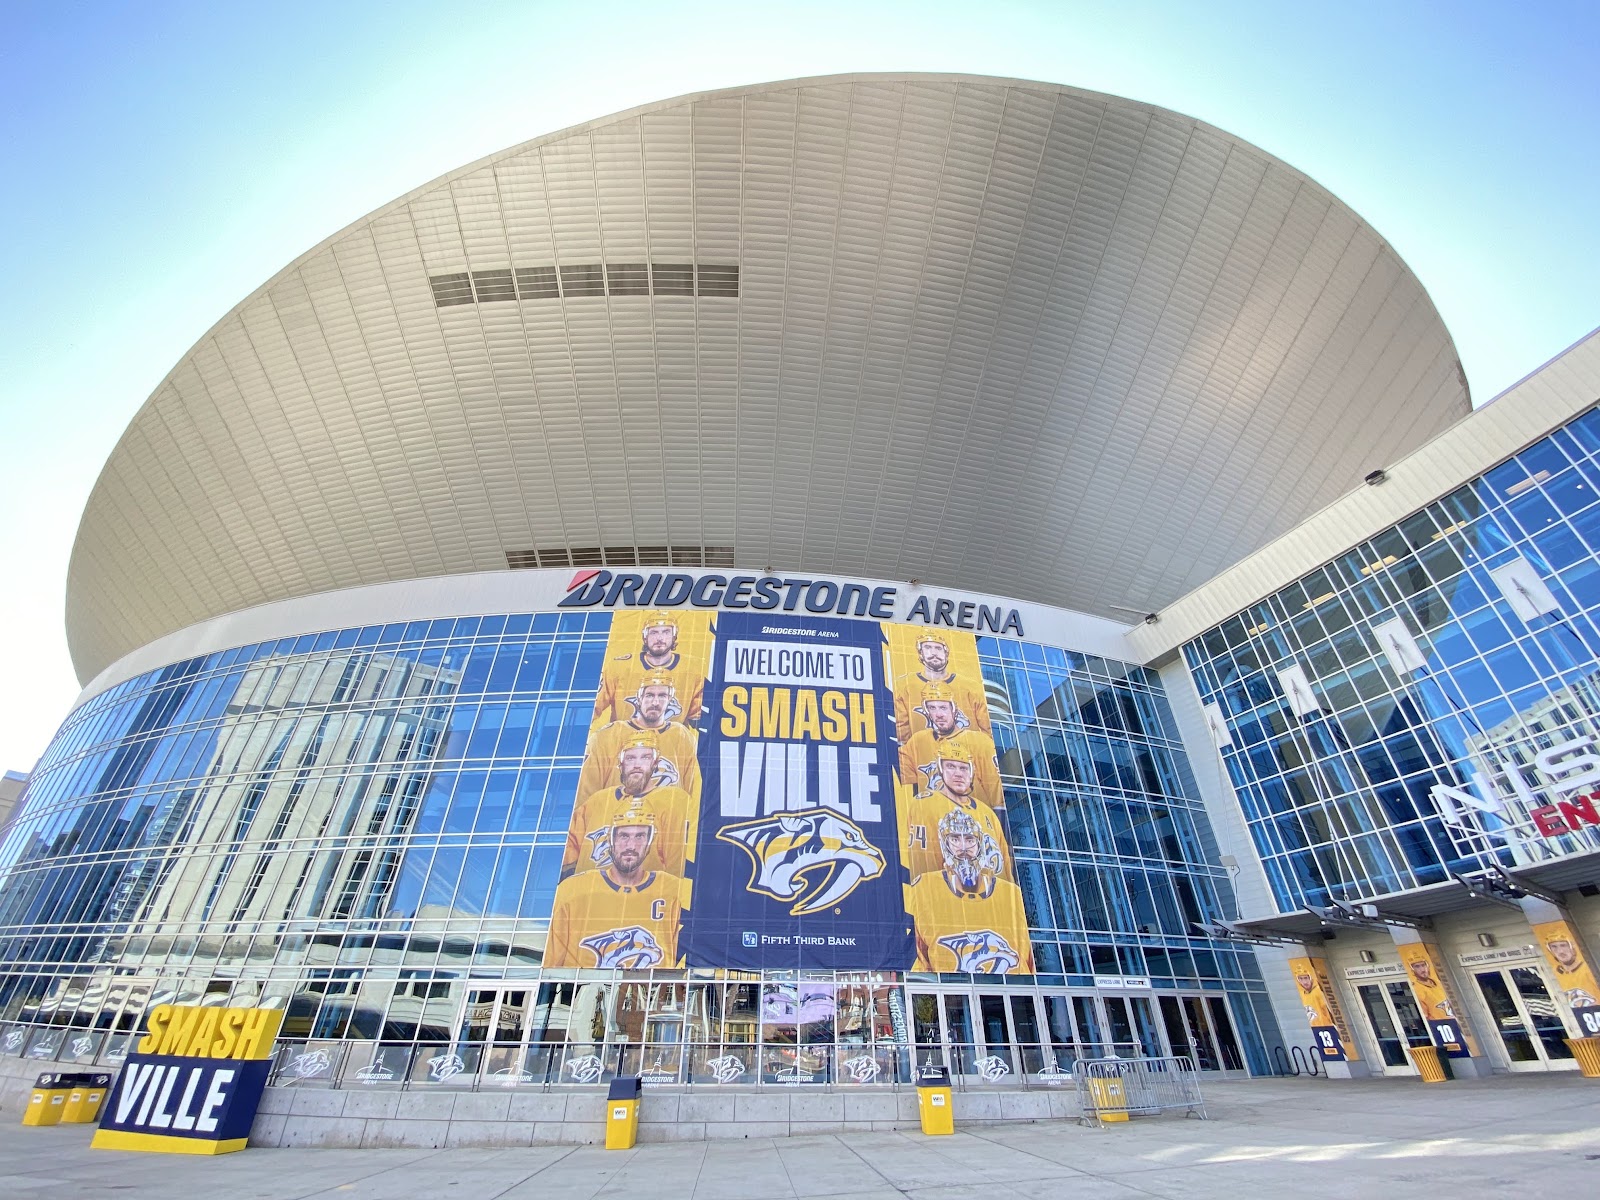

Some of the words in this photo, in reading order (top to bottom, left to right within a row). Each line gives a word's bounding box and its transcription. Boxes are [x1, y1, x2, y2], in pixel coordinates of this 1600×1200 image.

[557, 569, 897, 618] BRIDGESTONE
[906, 594, 1025, 637] ARENA
[761, 626, 816, 636] BRIDGESTONE
[817, 630, 840, 638] ARENA
[734, 645, 834, 678] WELCOME
[838, 653, 865, 681] TO
[720, 686, 877, 743] SMASH
[718, 740, 882, 823] VILLE
[1529, 790, 1600, 838] EN
[651, 898, 666, 921] C
[761, 935, 791, 945] FIFTH
[793, 936, 825, 945] THIRD
[828, 937, 857, 946] BANK
[137, 1003, 261, 1061] SMASH
[1318, 973, 1351, 1043] SMASHVILLE
[1318, 1030, 1334, 1047] 13
[1436, 1024, 1456, 1043] 10
[114, 1062, 236, 1133] VILLE
